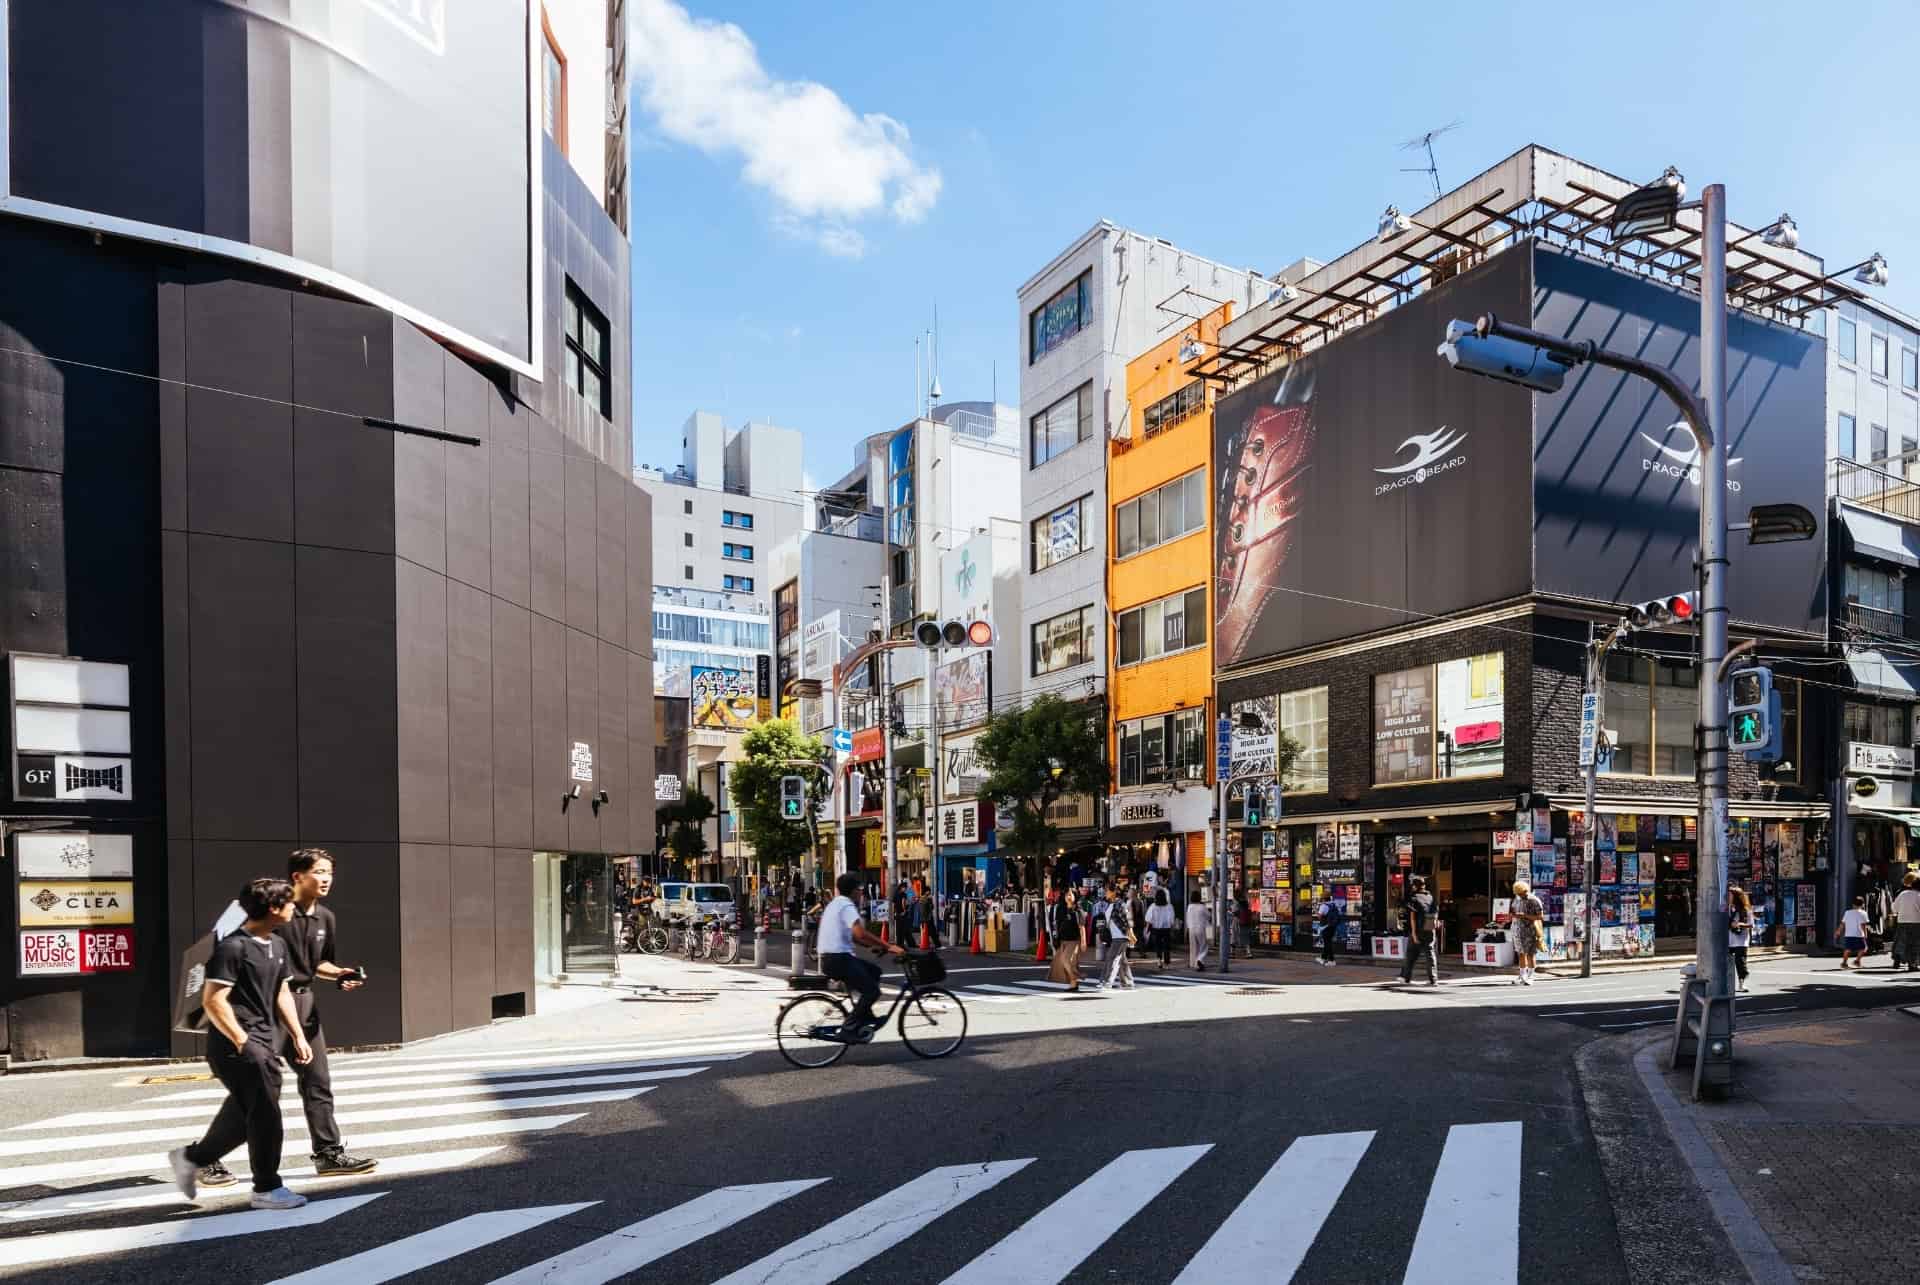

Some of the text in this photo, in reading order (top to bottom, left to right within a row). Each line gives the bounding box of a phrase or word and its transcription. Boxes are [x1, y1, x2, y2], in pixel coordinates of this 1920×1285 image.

[1385, 714, 1422, 727] HIGH ART
[1377, 726, 1430, 740] LOW CULTURE
[25, 769, 52, 784] 6F
[66, 897, 119, 909] CLEA
[25, 936, 55, 949] DEF
[85, 934, 115, 949] DEF
[25, 948, 76, 962] MUSIC
[85, 953, 130, 966] MALL
